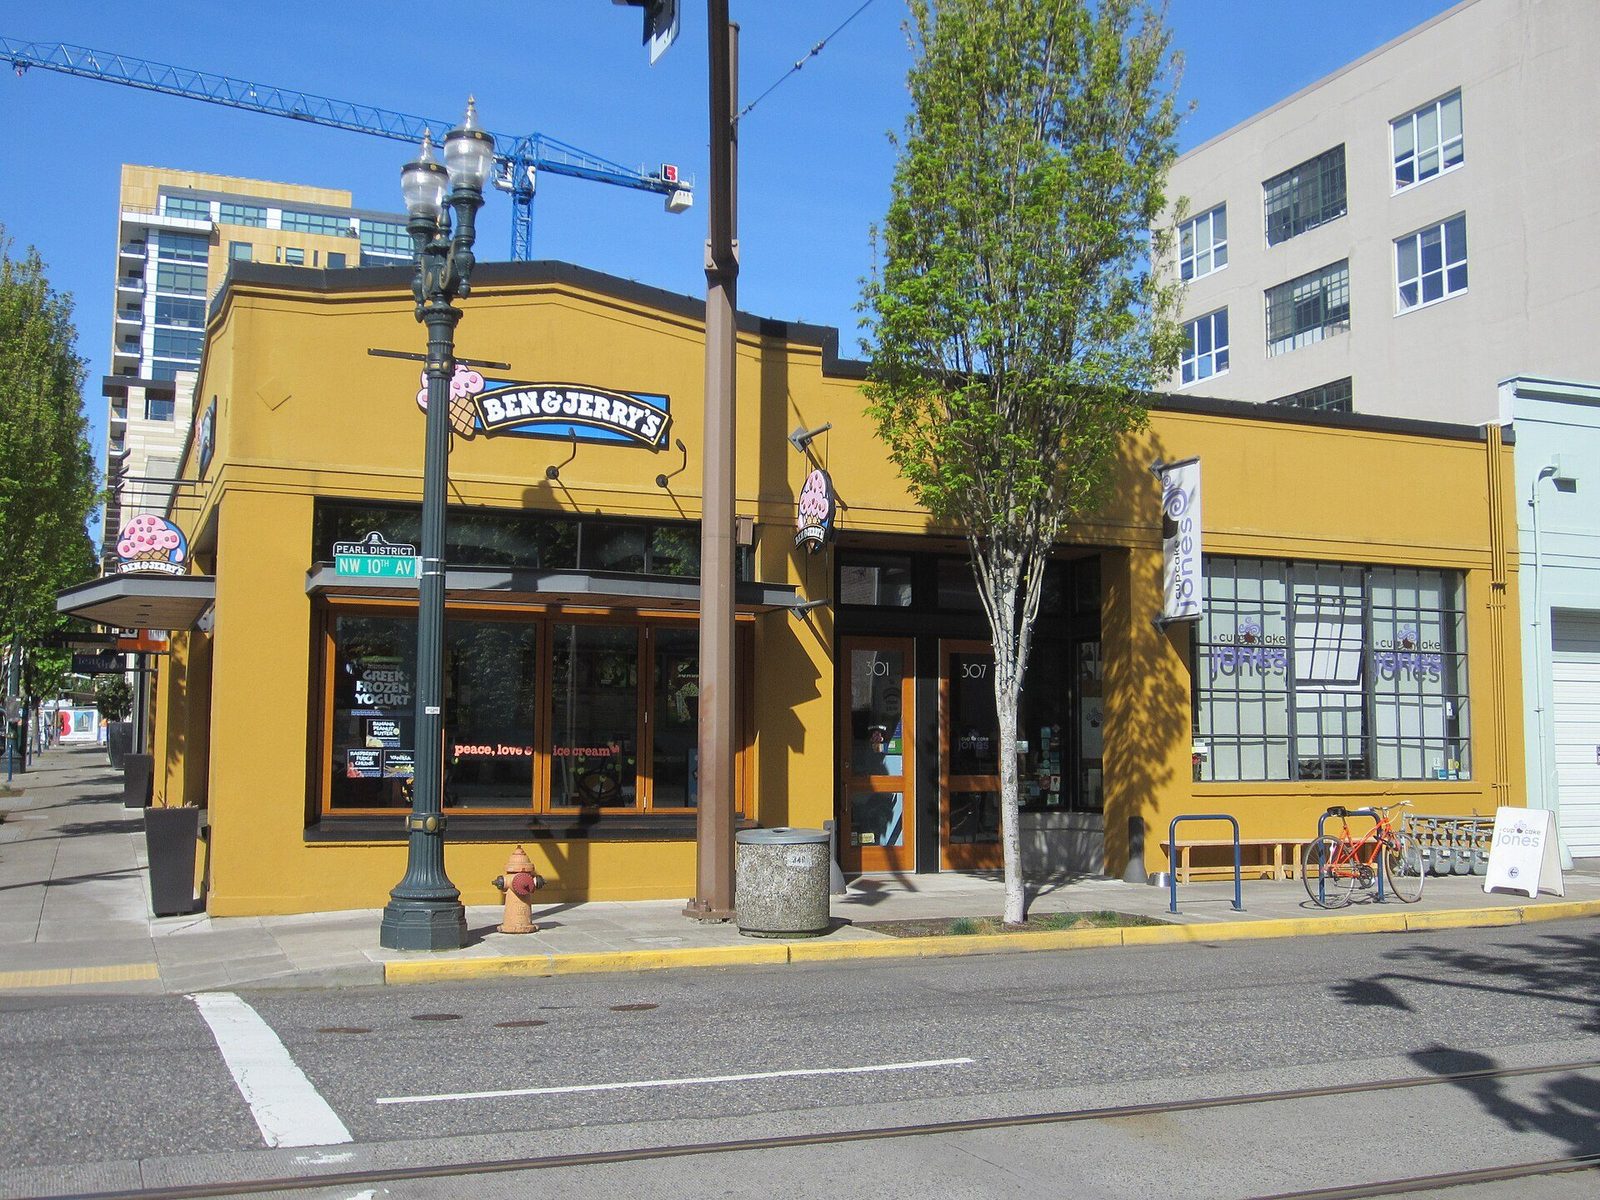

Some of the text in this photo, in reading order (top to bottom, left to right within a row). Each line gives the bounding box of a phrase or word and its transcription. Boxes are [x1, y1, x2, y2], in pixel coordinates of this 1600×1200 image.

[336, 545, 412, 556] PEARL DISTRICT
[340, 558, 412, 574] NW 10TH AV
[1174, 540, 1182, 600] cupcake
[1179, 517, 1198, 609] jones
[362, 670, 404, 681] GREEK
[866, 661, 889, 676] 301
[962, 664, 987, 679] 307
[356, 680, 409, 693] FROZEN
[355, 693, 411, 706] YOGURT
[454, 744, 495, 757] peace,
[497, 743, 523, 755] love
[553, 745, 570, 756] ice
[572, 747, 611, 757] cream
[1495, 832, 1540, 848] jones
